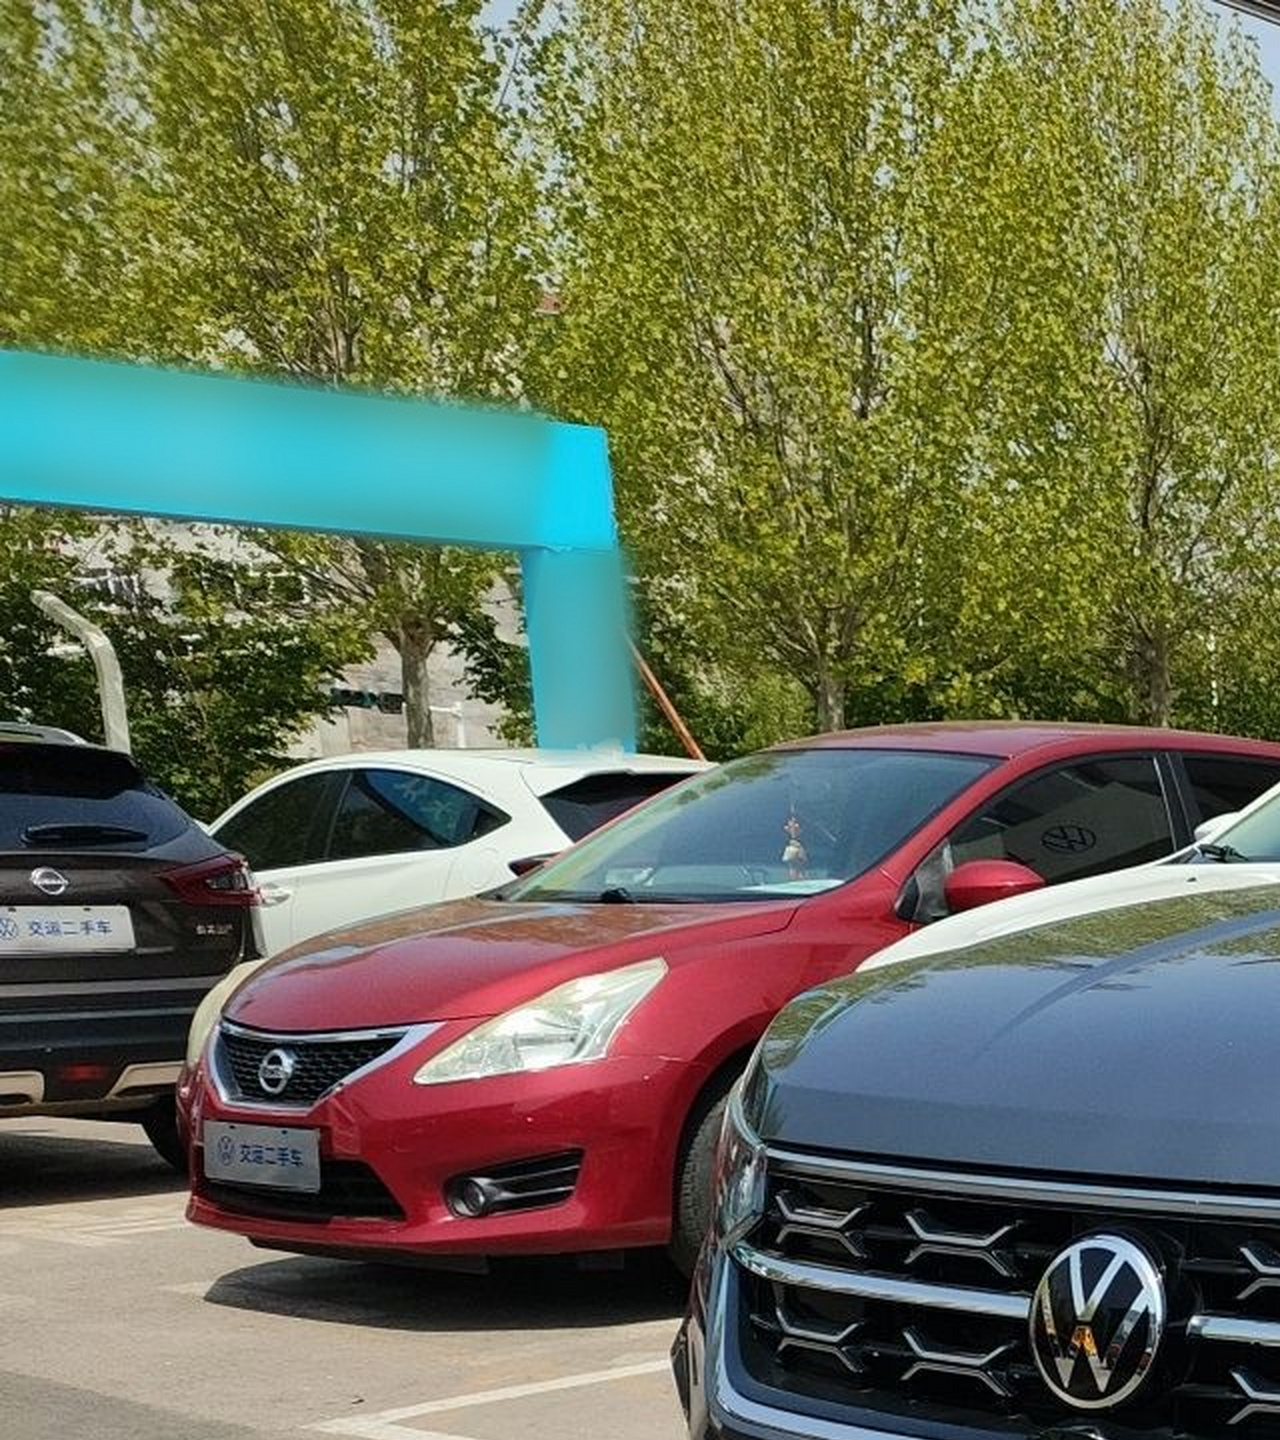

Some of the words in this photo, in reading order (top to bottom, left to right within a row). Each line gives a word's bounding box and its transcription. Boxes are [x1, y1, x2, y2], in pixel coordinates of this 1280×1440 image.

[27, 920, 113, 936] 交运二手车
[240, 1143, 305, 1167] 交运二手车
[1029, 1233, 1166, 1409] VW
